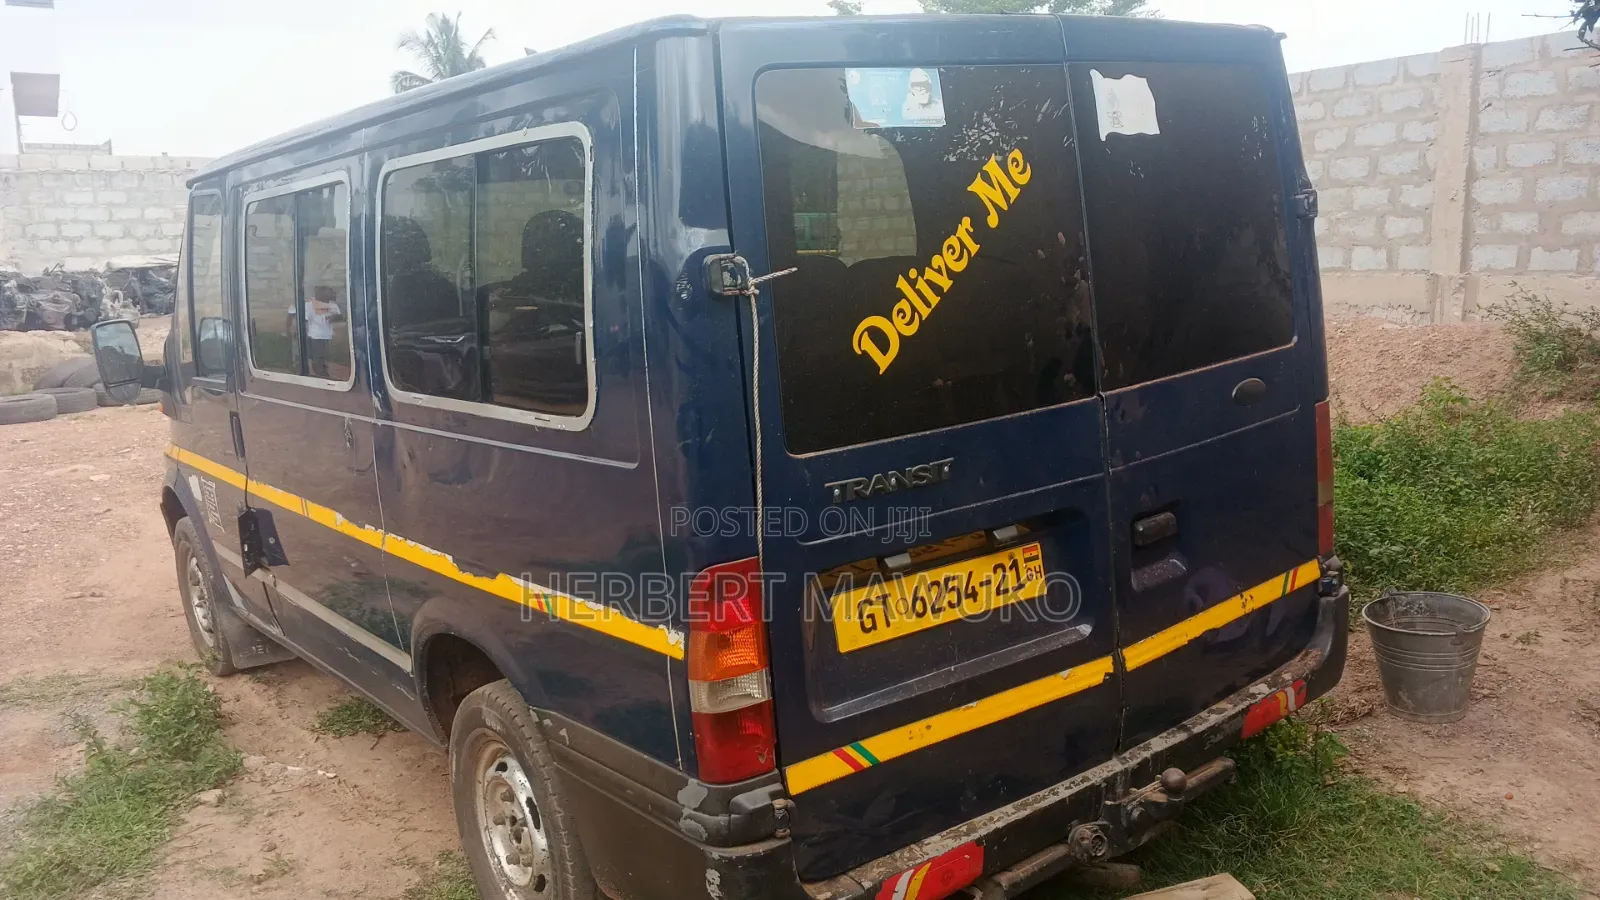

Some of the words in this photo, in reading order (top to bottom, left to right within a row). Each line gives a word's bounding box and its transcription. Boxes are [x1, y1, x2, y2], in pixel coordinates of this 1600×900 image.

[852, 216, 981, 375] Deliver
[967, 148, 1032, 229] Me
[824, 457, 954, 503] TRANSIT
[856, 592, 892, 634] GT
[910, 557, 1027, 619] 6254-21
[1025, 564, 1044, 583] GH
